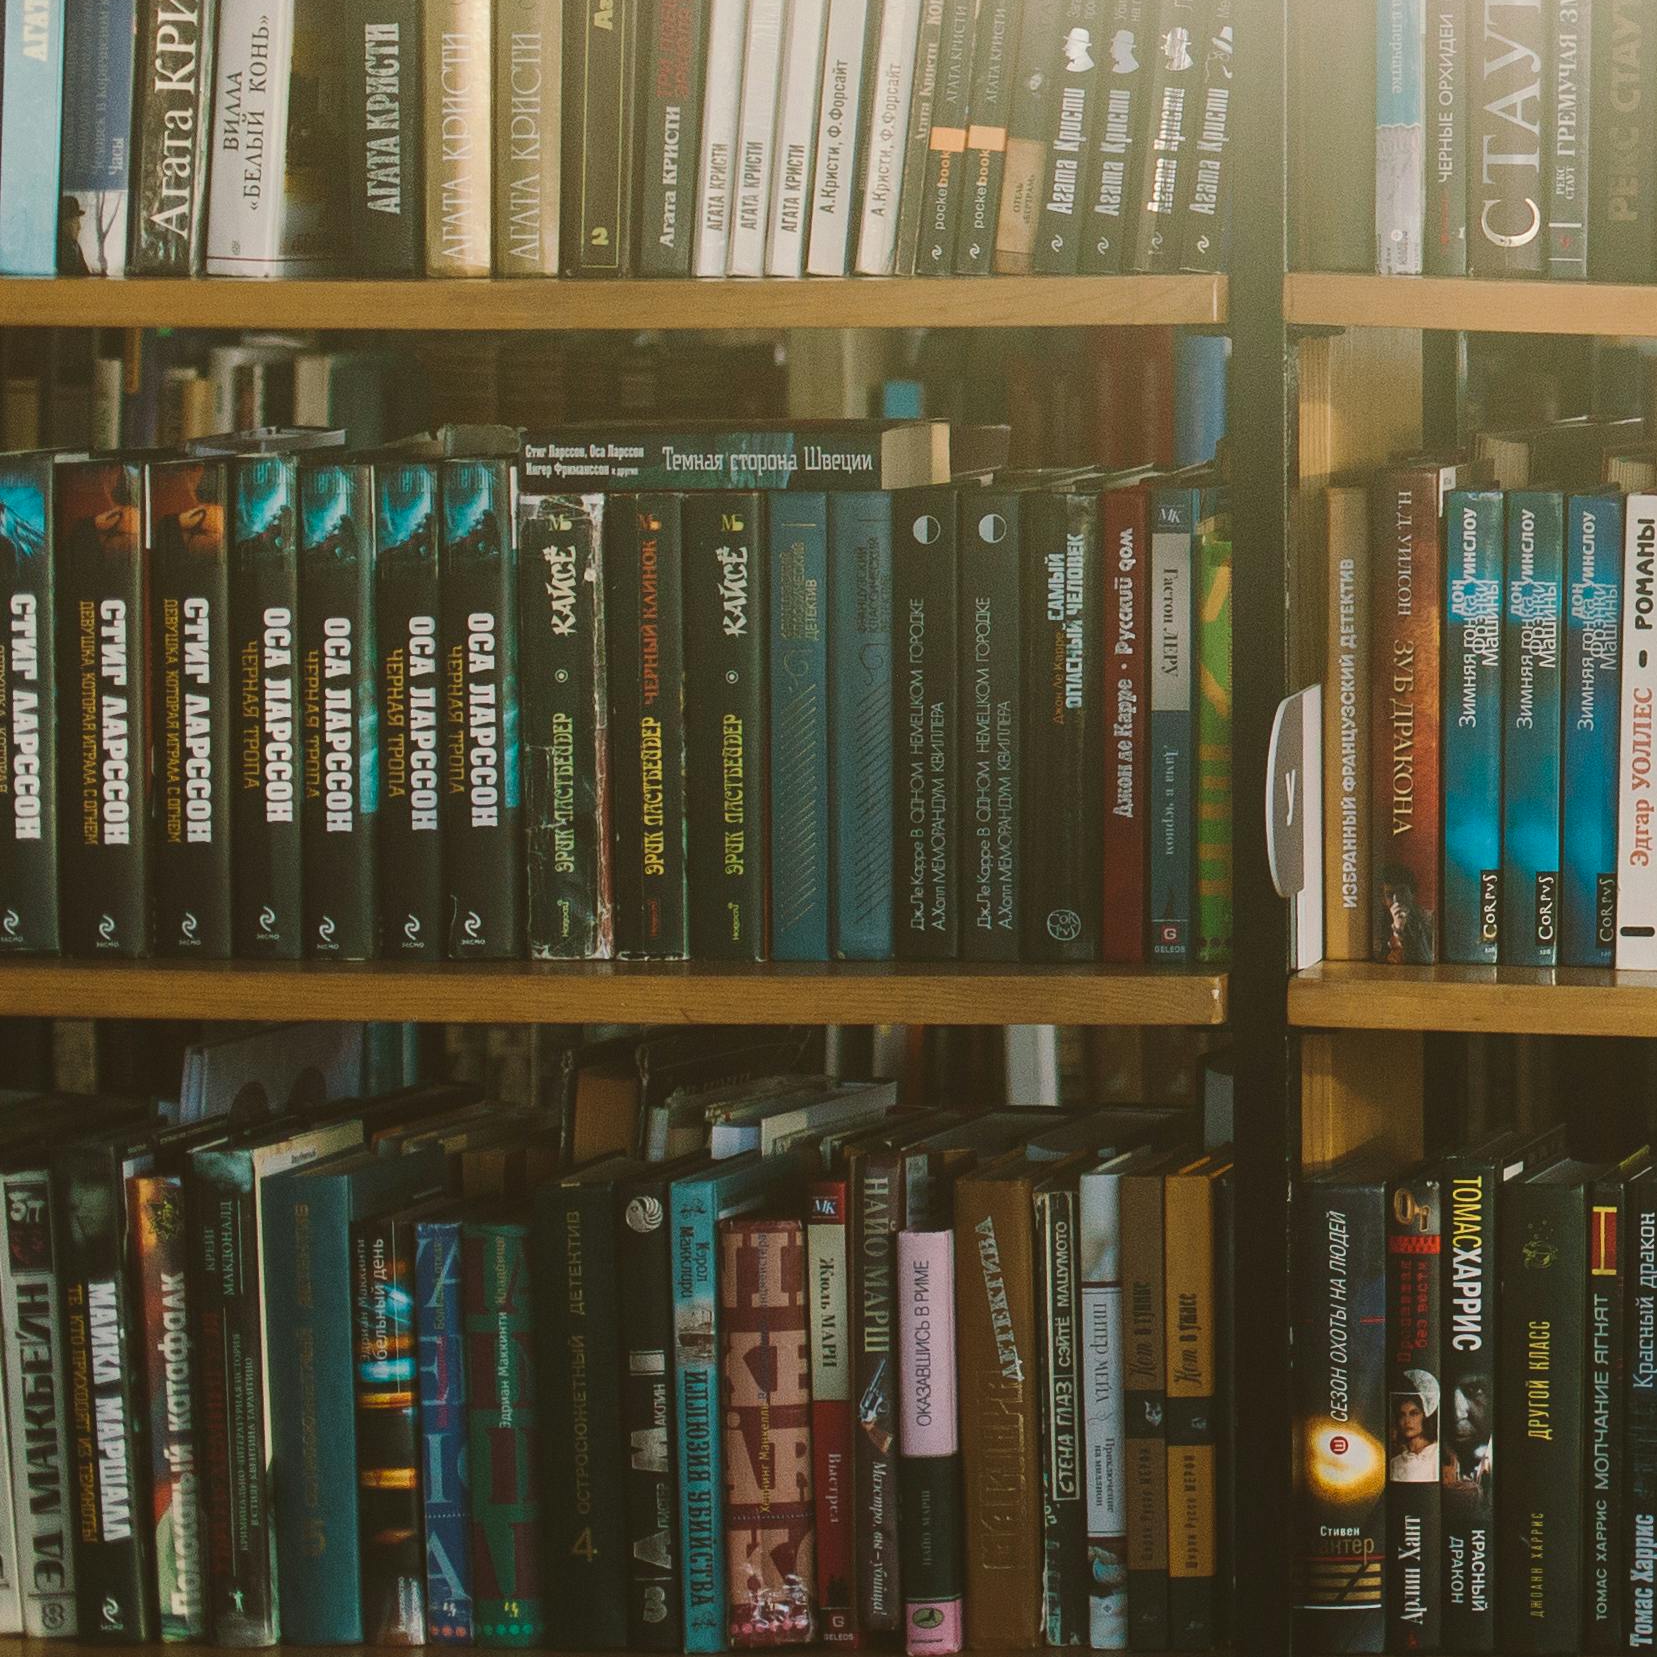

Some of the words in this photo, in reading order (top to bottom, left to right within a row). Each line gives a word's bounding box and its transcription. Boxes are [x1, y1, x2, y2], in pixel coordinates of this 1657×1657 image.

[511, 32, 542, 160] КРИСТИ
[1439, 14, 1454, 105] ОРХИДЕИ
[1557, 34, 1577, 157] ГРЕМУЧАЯ
[223, 71, 243, 150] ВИЛЛА
[663, 106, 682, 185] КРИСТИ
[1054, 89, 1087, 151] Кристи
[1438, 112, 1453, 183] ЧЕРНЫЕ
[150, 109, 193, 238] Агата
[742, 142, 763, 188] КРИСТИ
[1047, 161, 1076, 214] Агата
[509, 174, 541, 261] АГАТА
[660, 191, 679, 247] Агата
[740, 194, 760, 230] АГАТА
[662, 446, 723, 472] Темная
[731, 449, 798, 479] сторона
[804, 446, 872, 473] Швеции
[1339, 558, 1358, 649] ДЕТЕКТИВ
[1635, 518, 1655, 630] РОМАНЫ
[11, 595, 37, 679] СТИГ
[264, 608, 291, 667] ОСА
[1393, 640, 1413, 691] ЗУБ
[243, 641, 258, 717] ЧЕРНАЯ
[244, 725, 260, 788] ТРОПА
[266, 678, 293, 822] ЛАРССОН
[930, 702, 945, 771] КВИЛЛЕРА
[1339, 654, 1357, 791] ФРАНЦУЗСКИЙ
[1633, 688, 1653, 790] УОЛЛЕС
[13, 693, 41, 838] ЛАРССОН
[1393, 698, 1416, 835] ДРАКОНА
[931, 778, 946, 883] МЕМОРАНДУМ
[1340, 797, 1358, 908] ИЗБРАННЫЙ
[1630, 799, 1653, 866] Эдгар
[368, 1239, 387, 1280] день
[913, 1260, 930, 1300] РИМЕ
[1326, 1212, 1348, 1273] ЛЮДЕЙ
[915, 1305, 930, 1316] В
[974, 1217, 1025, 1381] ДЕТЕКТИВА
[1329, 1279, 1347, 1300] НА
[87, 1281, 117, 1384] МАЙКЛ
[496, 1312, 510, 1376] Маккинти
[1328, 1304, 1349, 1363] ОХОТЫ
[1528, 1321, 1551, 1370] КЛАСС
[1633, 1296, 1656, 1388] Красный
[15, 1283, 61, 1515] МАКБЕЙН
[498, 1380, 512, 1428] Эдриан
[915, 1321, 932, 1426] ОКАЗАВШИСЬ
[1329, 1370, 1349, 1423] СЕЗОН
[1526, 1380, 1553, 1441] ДРУГОЙ
[682, 1371, 713, 1481] ИЛЛЮЗИЯ
[95, 1398, 131, 1540] МАРШАЛЛ
[31, 1530, 66, 1590] ЭД
[684, 1490, 715, 1607] УБИЙСТВА
[1631, 1588, 1654, 1647] Томас
